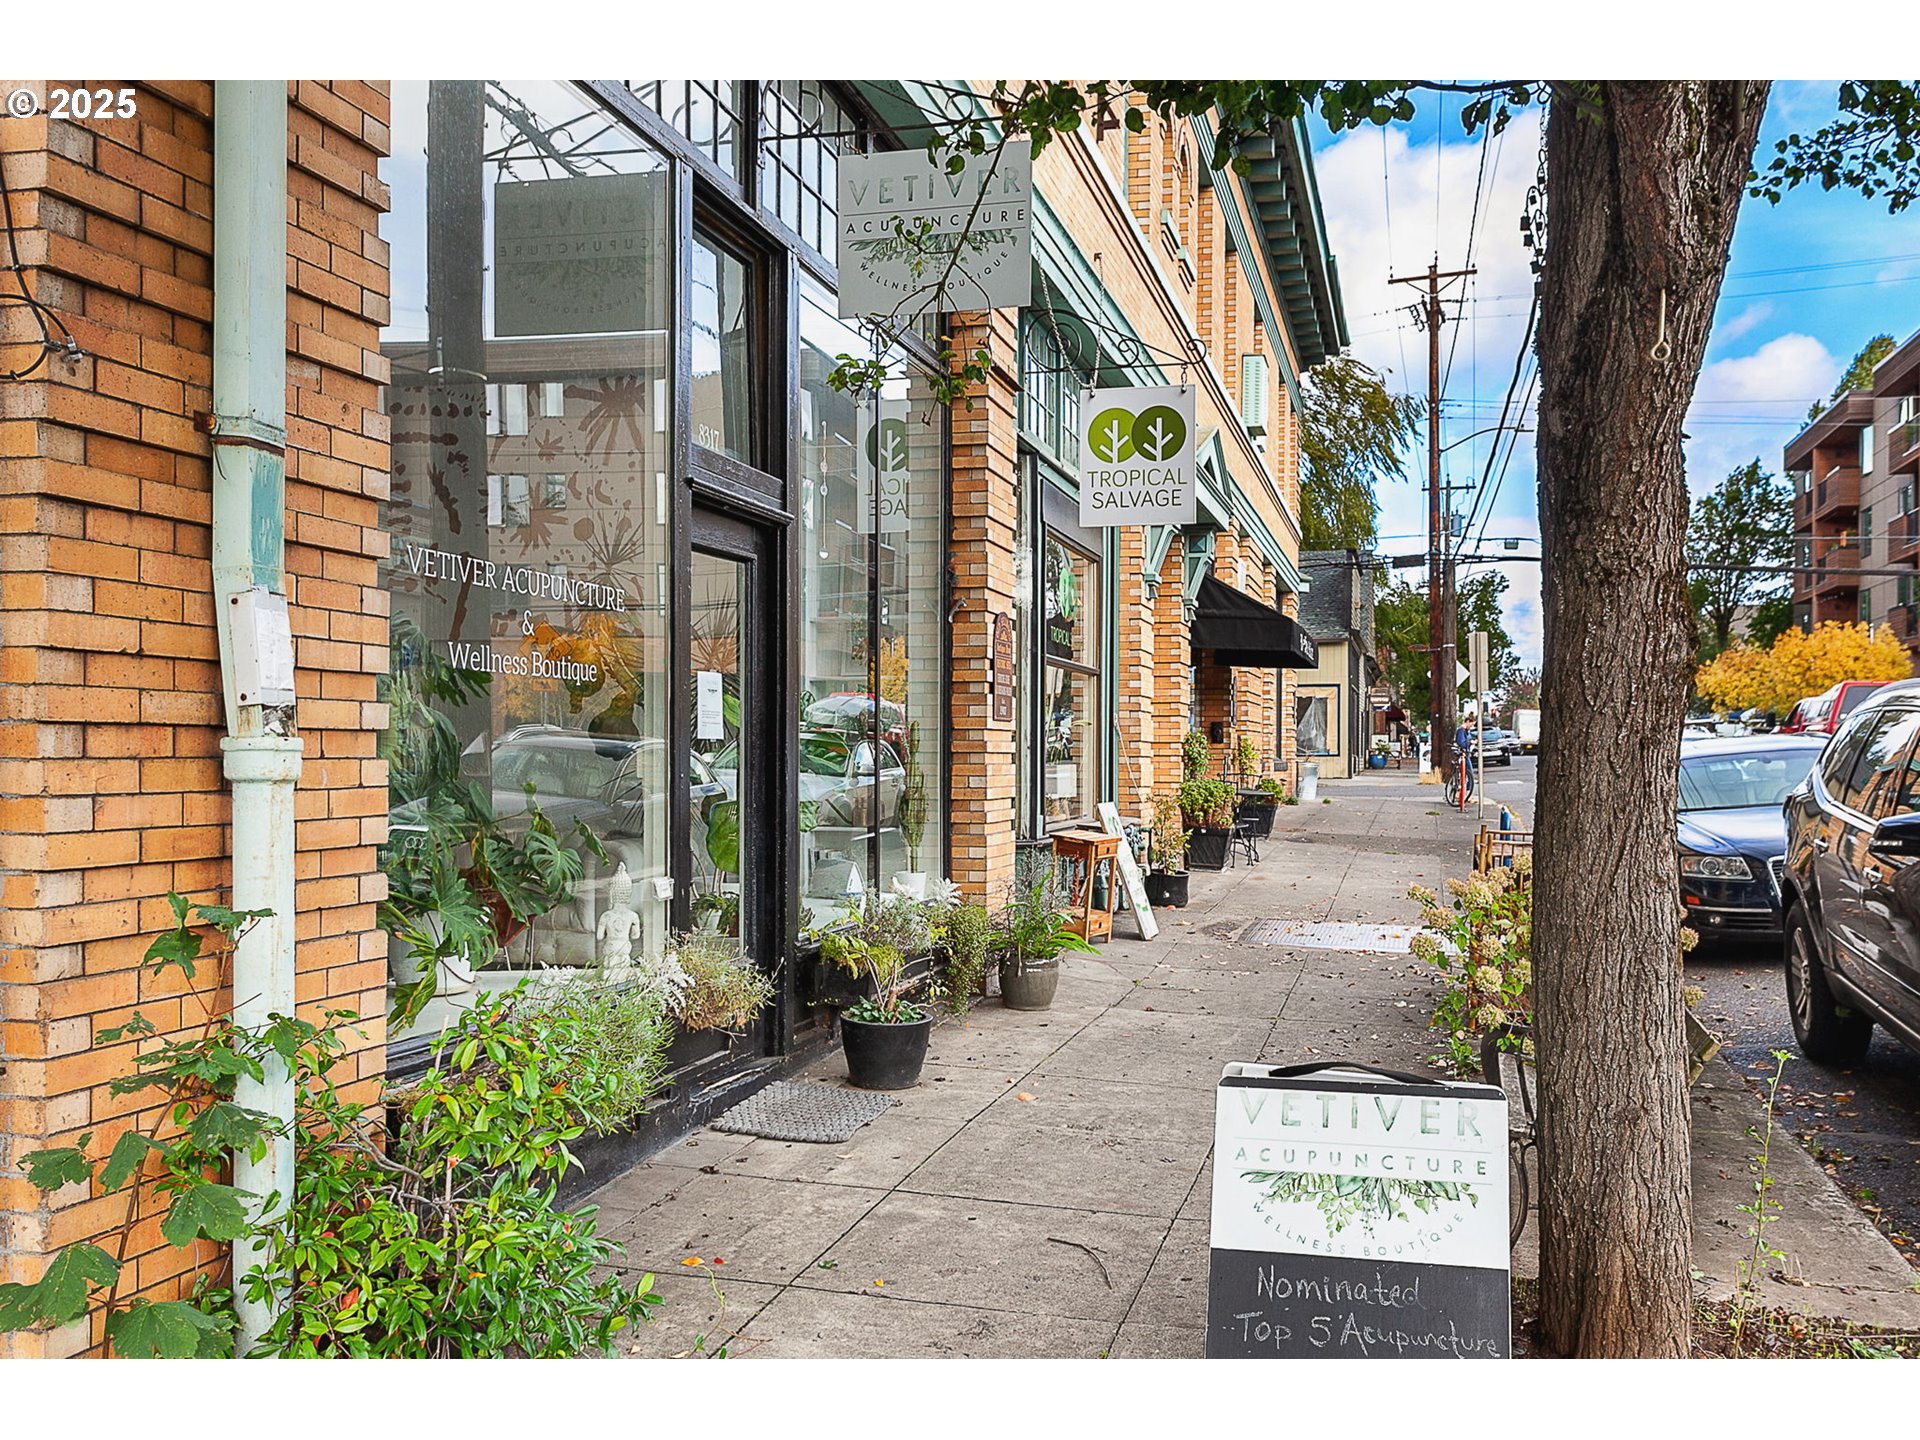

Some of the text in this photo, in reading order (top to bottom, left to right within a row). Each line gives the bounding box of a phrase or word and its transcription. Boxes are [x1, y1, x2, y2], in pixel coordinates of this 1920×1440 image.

[847, 167, 1021, 206] VETIVER
[846, 208, 1025, 235] ACUPUNCURE
[945, 251, 1009, 291] OUIQUE
[699, 423, 720, 452] 8317
[1086, 467, 1188, 489] TROPICAL
[1091, 488, 1183, 510] SALVAGE
[406, 544, 627, 613] VETIVER ACUPUNCTURE
[522, 609, 535, 636] &
[448, 641, 598, 686] Wellness Boutique
[1240, 1090, 1482, 1138] VETIVER
[1234, 1146, 1488, 1176] ACUPUNCTURE
[1252, 1201, 1464, 1257] WELLNESS BOUTIQUE
[1257, 1264, 1422, 1307] Nominated
[1232, 1311, 1501, 1360] Top 5 Acupuncture
